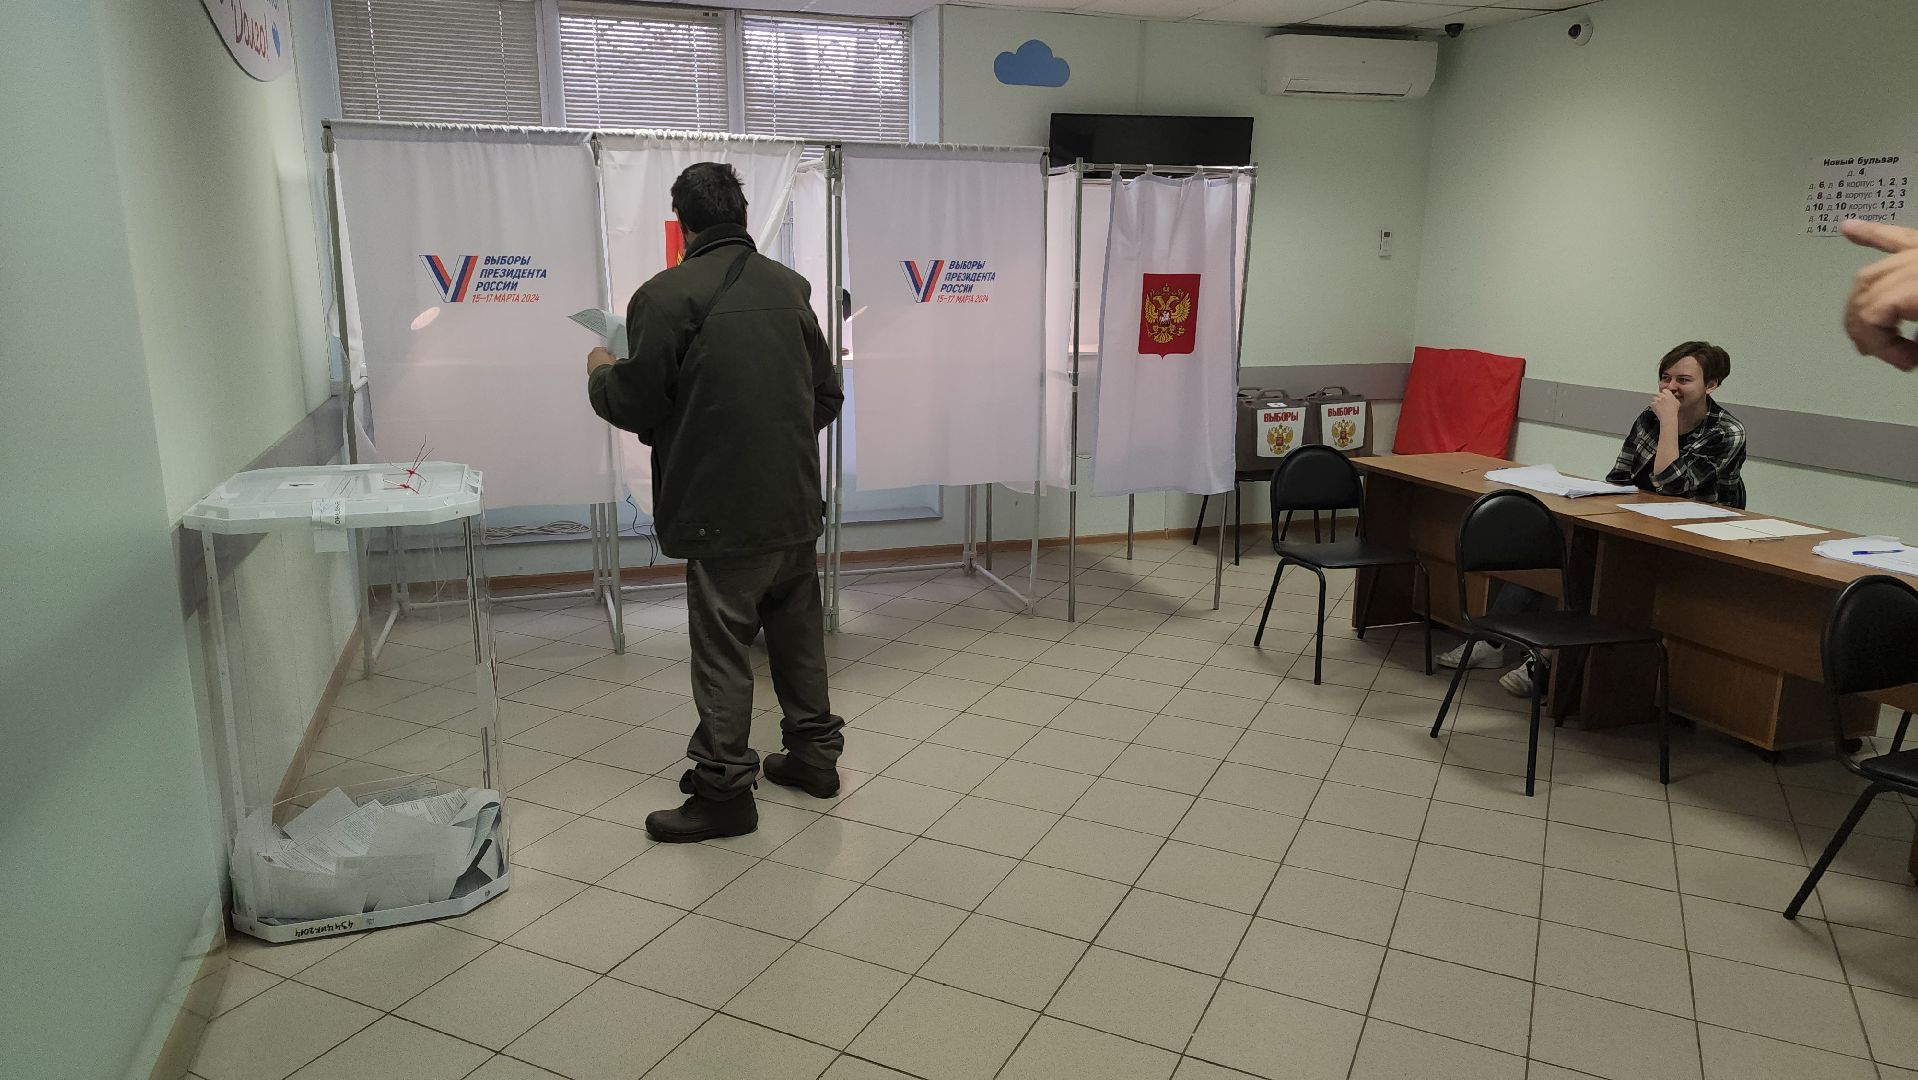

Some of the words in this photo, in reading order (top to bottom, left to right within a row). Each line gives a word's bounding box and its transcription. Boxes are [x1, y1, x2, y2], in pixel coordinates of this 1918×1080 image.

[1824, 157, 1854, 166] Новый
[1857, 156, 1899, 166] бульвар
[1838, 180, 1844, 188] 6
[1846, 180, 1875, 188] корпус
[1901, 177, 1908, 186] 3
[1836, 191, 1843, 199] 8
[1845, 191, 1874, 200] корпус
[1899, 189, 1906, 197] 3
[1848, 202, 1878, 211] корпус
[484, 255, 532, 266] ВЫБОРЫ
[948, 260, 986, 270] ВЫБОРЫ
[479, 268, 548, 280] ПРЕЗИДЕНТА
[944, 271, 996, 282] ПРЕЗИДЕНТА
[475, 281, 519, 292] РОССИИ
[940, 283, 974, 293] РОССИИ
[494, 293, 520, 302] МАРТА
[521, 293, 540, 302] 2024
[954, 294, 974, 303] МАРТА
[1263, 411, 1299, 423] ВЫБОРЫ
[1327, 406, 1360, 417] ВЫБОРЫ
